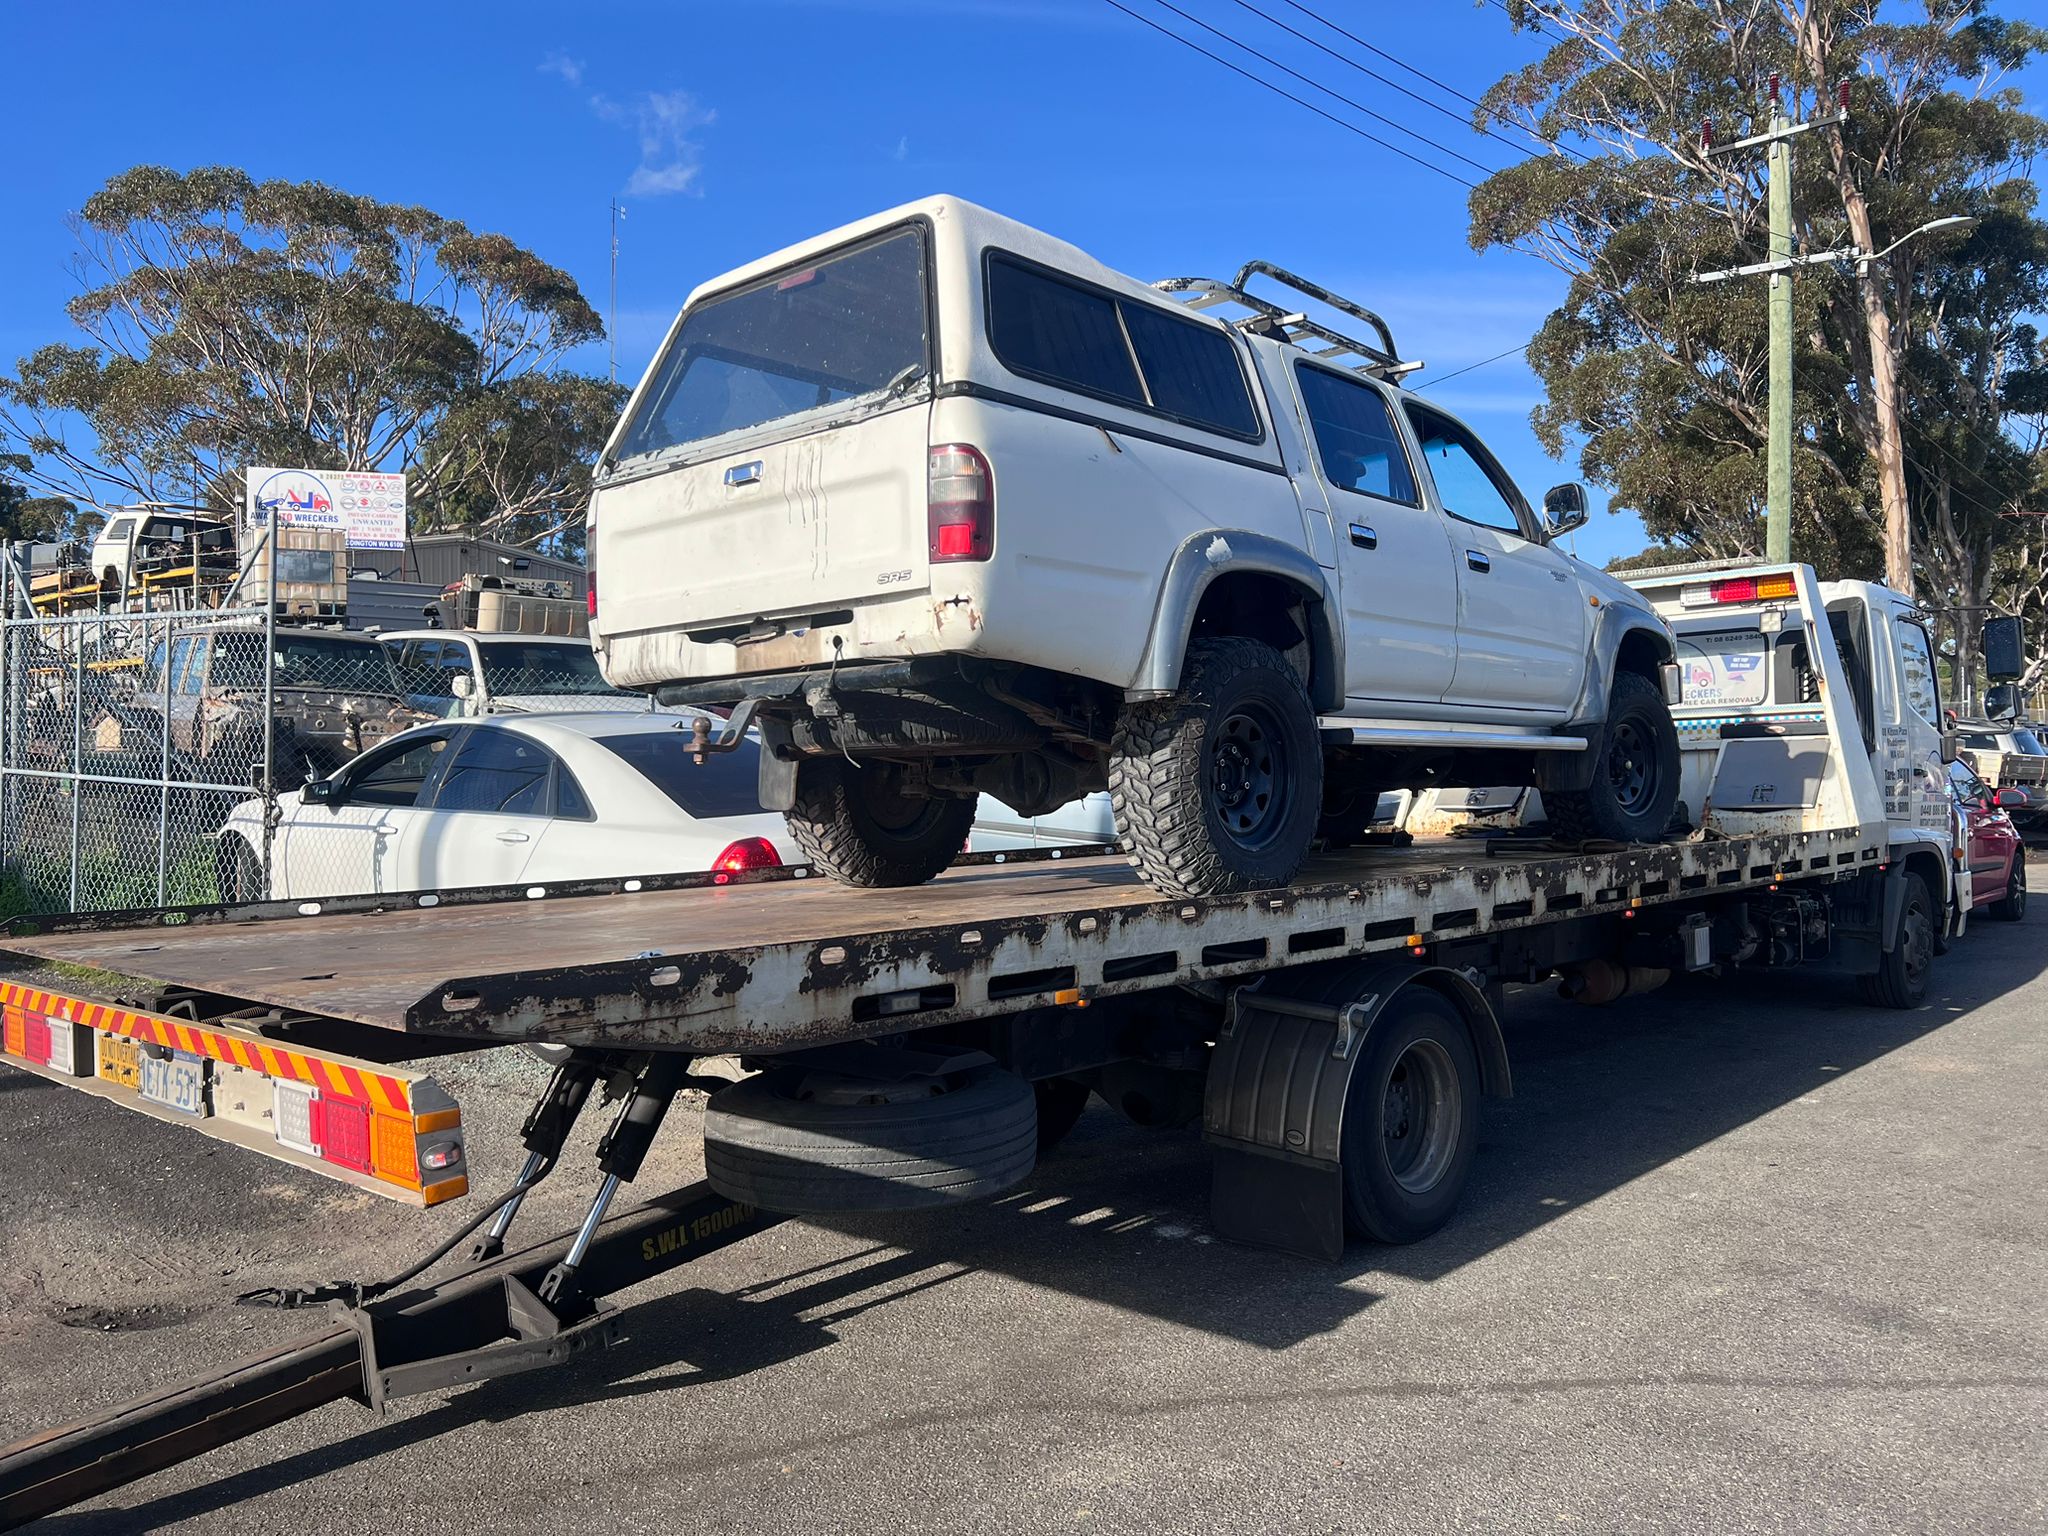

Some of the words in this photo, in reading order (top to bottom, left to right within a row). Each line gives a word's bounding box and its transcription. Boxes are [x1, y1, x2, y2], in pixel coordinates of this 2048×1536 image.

[294, 514, 339, 523] WRECKERS
[352, 518, 394, 526] UNWANTED
[877, 569, 912, 585] SR5
[1684, 688, 1723, 699] ECKERS
[1718, 696, 1760, 704] REMOVALS
